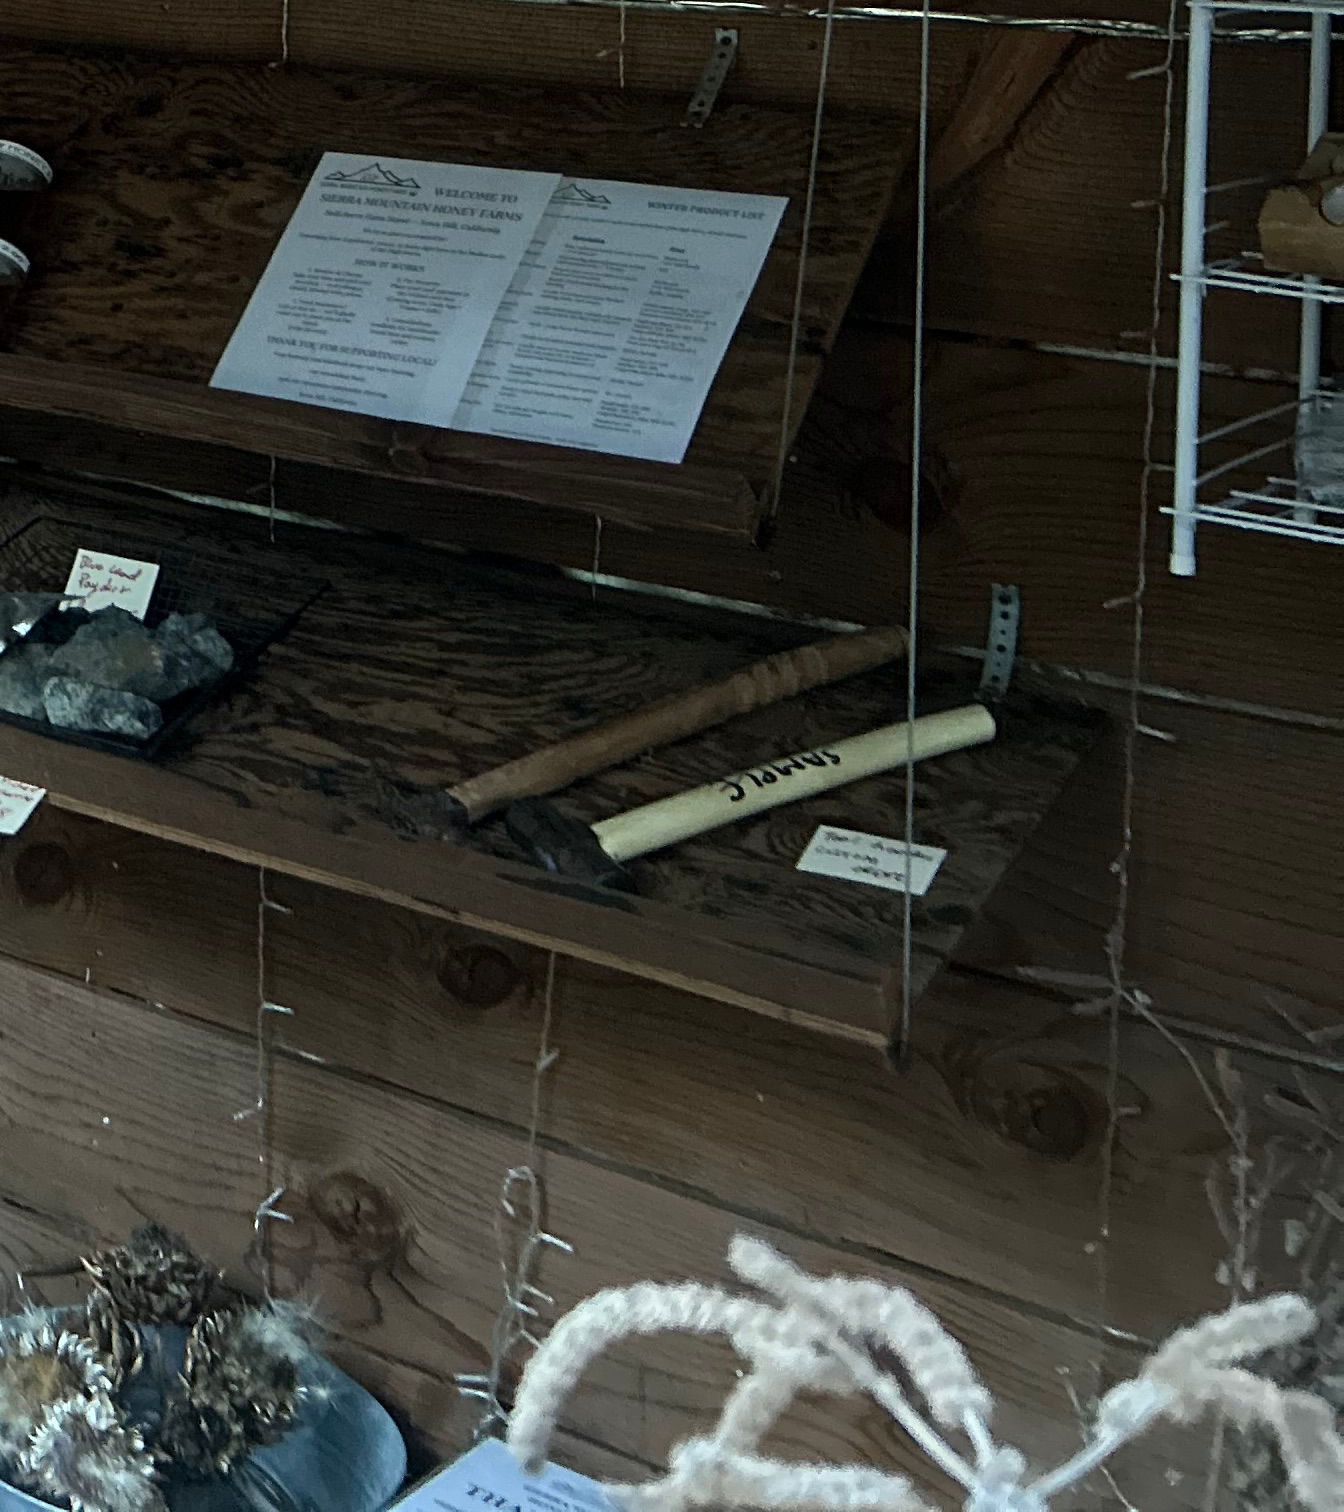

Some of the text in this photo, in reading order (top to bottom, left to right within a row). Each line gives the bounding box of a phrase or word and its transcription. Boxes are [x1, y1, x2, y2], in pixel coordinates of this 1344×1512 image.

[434, 187, 519, 204] WELCOME TO
[319, 193, 523, 222] SIERRA MOUNTAIN HONEY FARMS
